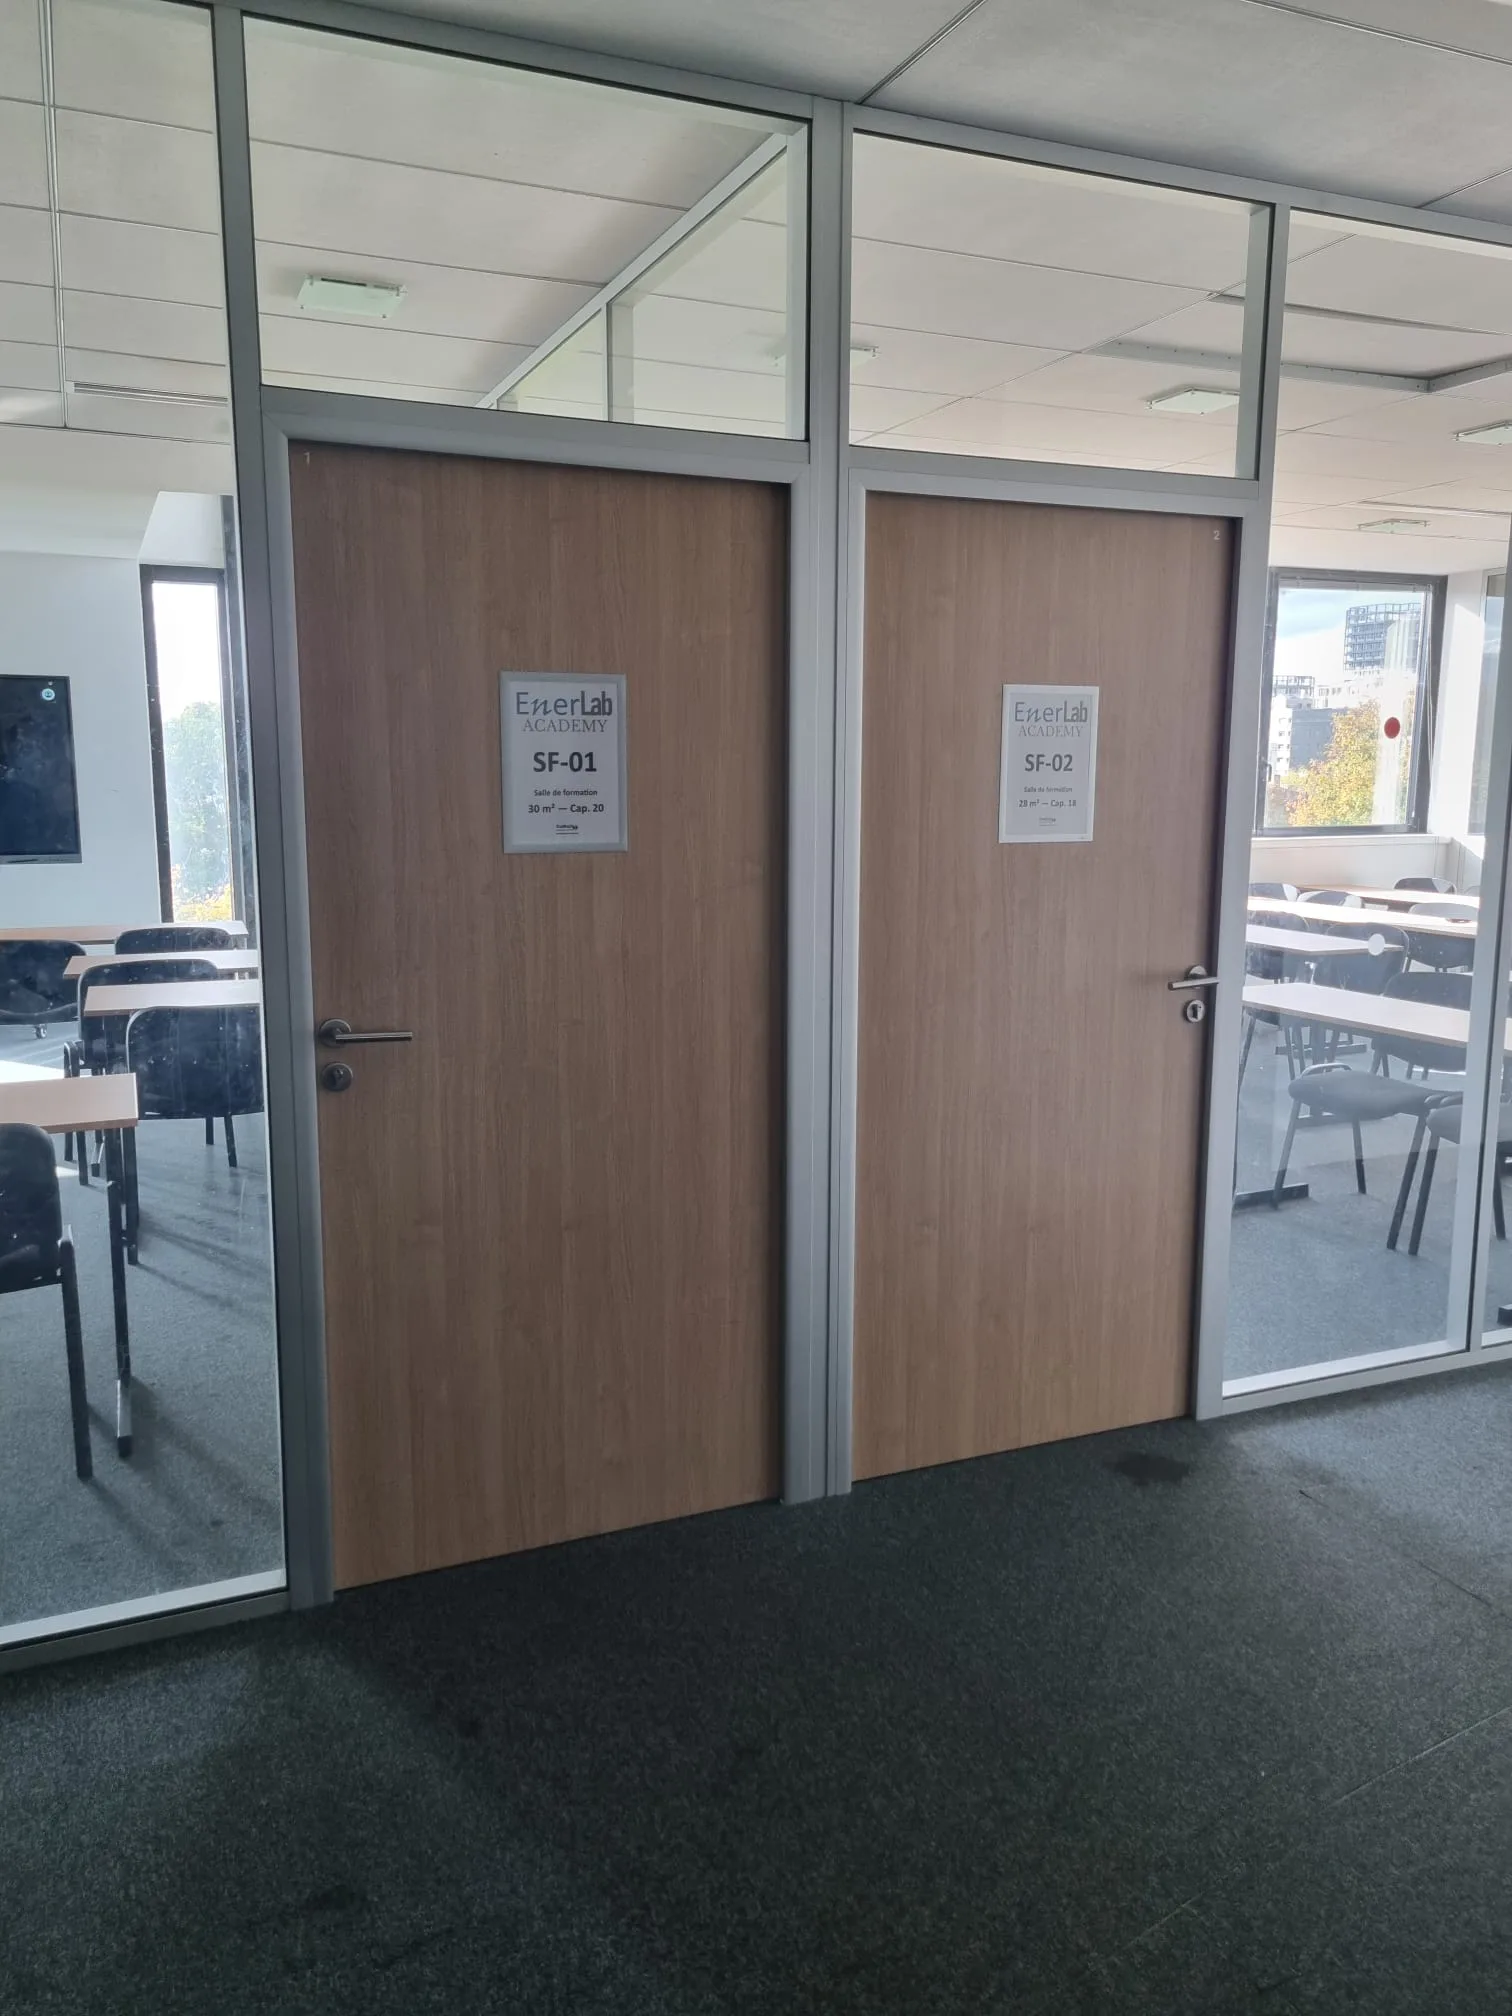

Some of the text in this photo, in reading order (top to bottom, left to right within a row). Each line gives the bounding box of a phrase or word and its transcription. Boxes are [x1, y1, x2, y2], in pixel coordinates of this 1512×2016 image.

[1213, 530, 1220, 540] 2
[516, 691, 612, 716] EnerLab
[1015, 701, 1087, 722] EnerLab
[523, 719, 607, 733] ACADEMY
[1018, 726, 1083, 737] ACADEMY
[533, 752, 597, 772] SF-01
[1024, 754, 1073, 771] SF-02
[534, 789, 598, 797] Salle de formation
[528, 804, 540, 813] 30
[542, 803, 555, 813] m²
[570, 804, 590, 814] Cap.
[592, 803, 604, 812] 20
